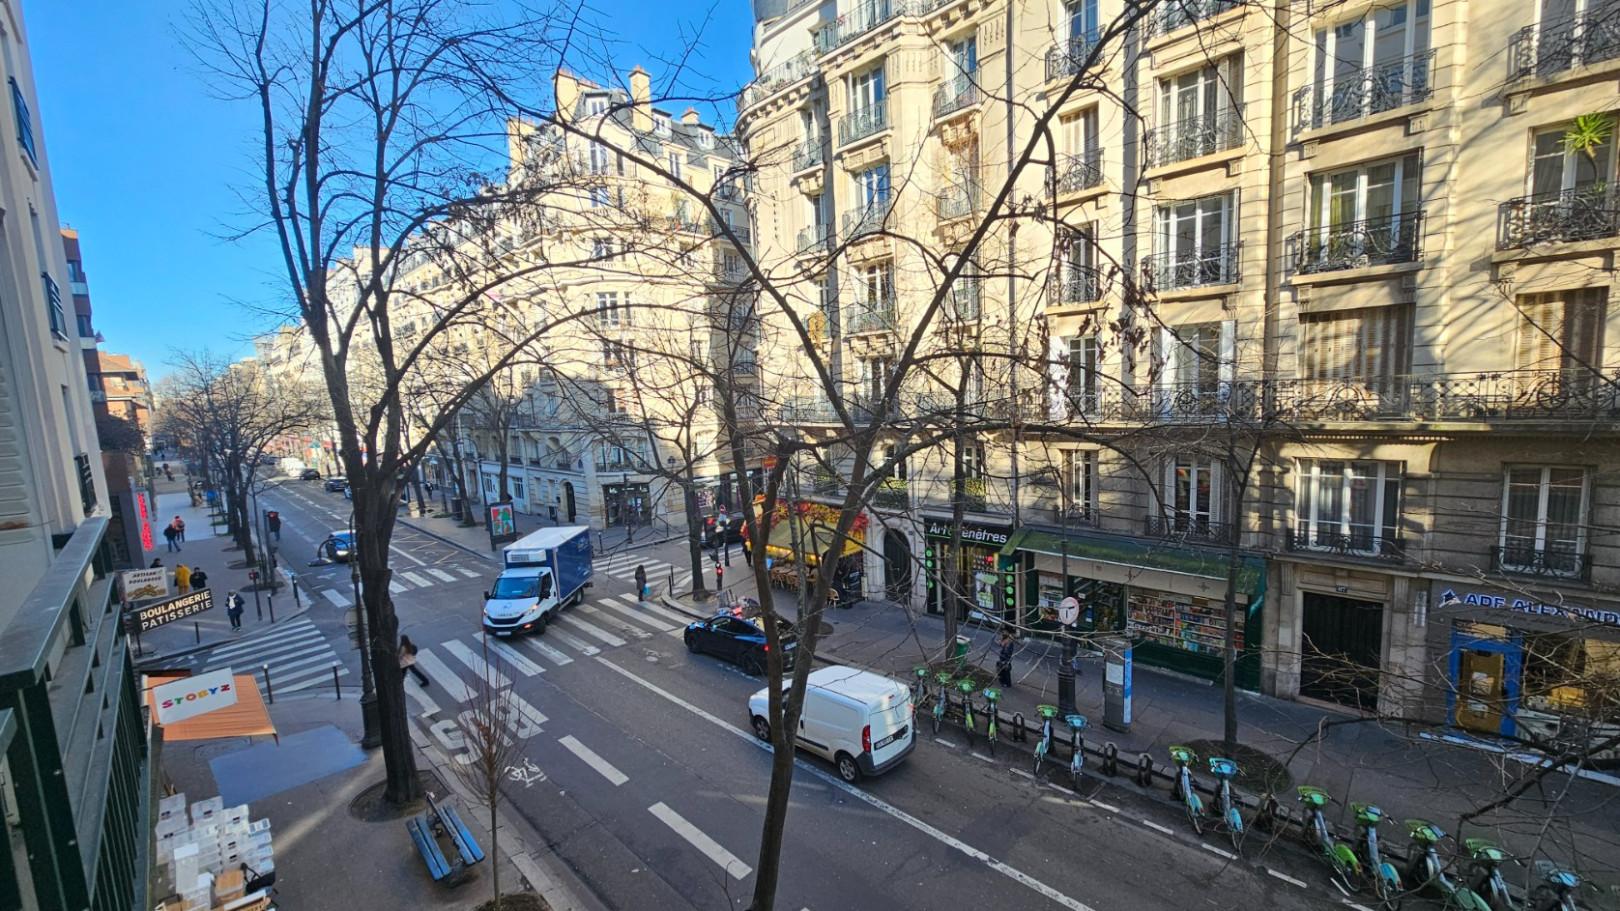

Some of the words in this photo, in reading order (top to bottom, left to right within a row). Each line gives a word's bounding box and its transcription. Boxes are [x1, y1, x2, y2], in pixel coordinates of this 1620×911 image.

[139, 590, 211, 621] BOULANGERIE
[141, 600, 213, 631] PATISSERIE
[1511, 599, 1620, 625] ALEXAND
